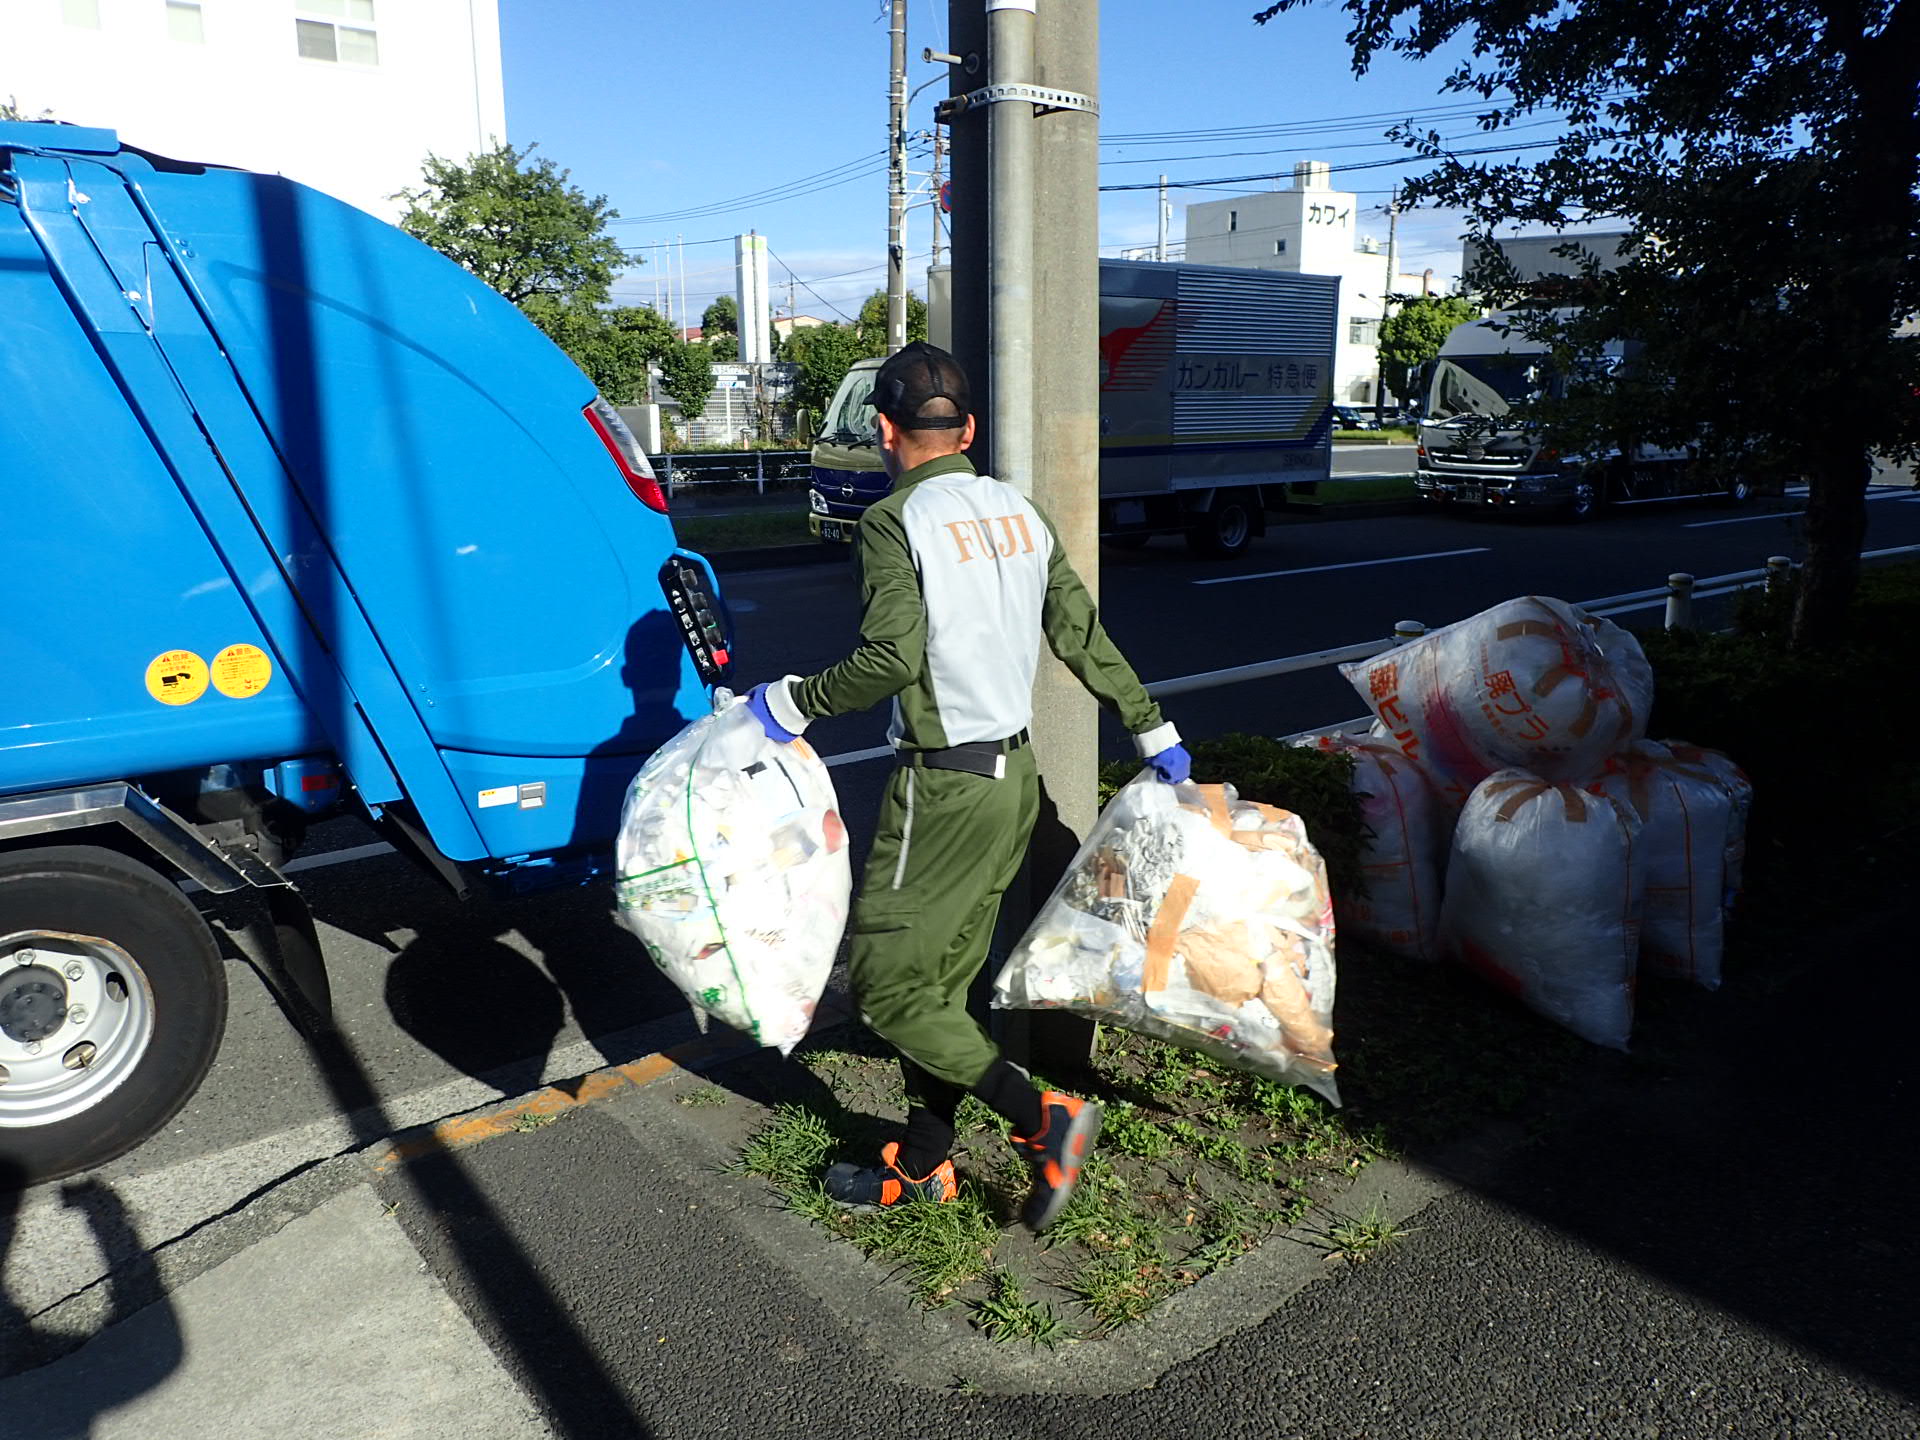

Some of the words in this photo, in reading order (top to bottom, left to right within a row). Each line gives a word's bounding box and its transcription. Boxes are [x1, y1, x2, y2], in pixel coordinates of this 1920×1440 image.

[1308, 204, 1350, 227] カワイ
[1177, 363, 1259, 389] カンガルー
[1267, 363, 1318, 389] 特急便
[944, 514, 1034, 564] FUJI
